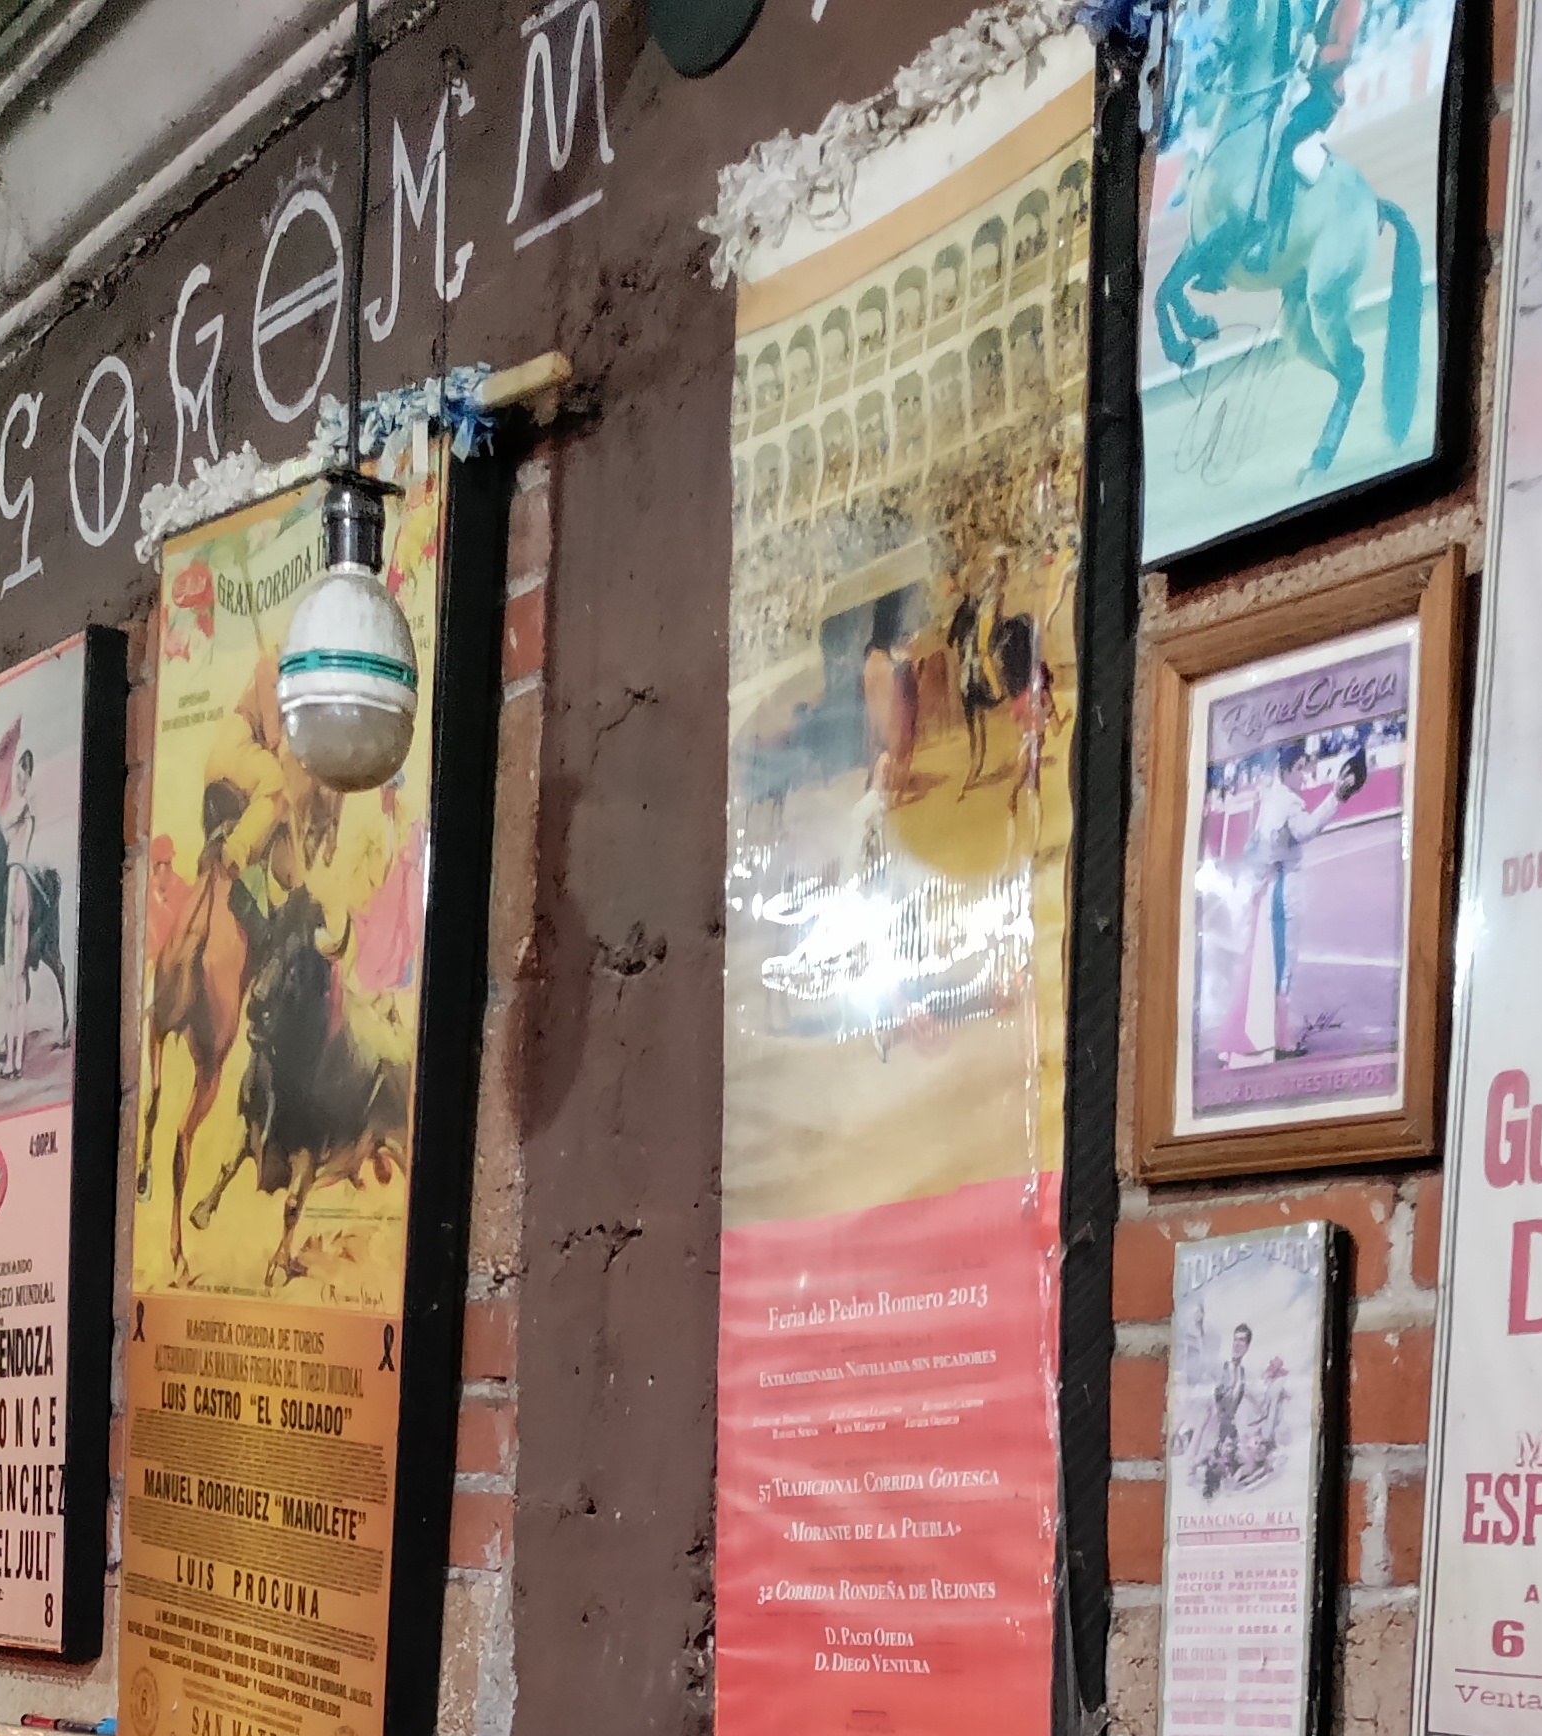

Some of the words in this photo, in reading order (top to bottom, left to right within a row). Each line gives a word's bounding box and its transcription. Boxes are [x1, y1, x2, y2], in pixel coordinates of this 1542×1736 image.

[216, 572, 254, 617] GRAN
[256, 545, 313, 614] CORRIDA
[1301, 671, 1398, 720] Ortega
[768, 1303, 806, 1332] Feria
[808, 1301, 826, 1326] de
[828, 1295, 875, 1323] Pedro
[877, 1290, 945, 1316] Romero
[946, 1283, 989, 1309] 2013
[160, 1380, 187, 1412] LUIS
[193, 1384, 242, 1421] CASTRO
[143, 1467, 194, 1506] MANUEL
[196, 1478, 271, 1522] RODRIGUEZ
[758, 1484, 772, 1504] 57
[771, 1476, 862, 1498] TRADICIONAL
[862, 1470, 925, 1493] CORRIDA
[928, 1466, 1001, 1489] GOYESCA
[854, 1524, 874, 1540] DE
[876, 1522, 898, 1540] LA
[175, 1554, 215, 1592] LUIS
[232, 1568, 320, 1620] PROCUNA
[774, 1579, 836, 1601] CORRIDA
[838, 1579, 907, 1601] RONDEÑA
[908, 1583, 928, 1600] DE
[930, 1578, 997, 1600] REJONES
[1524, 1583, 1540, 1604] A
[44, 1592, 54, 1628] 8
[873, 1627, 915, 1647] OJEDA
[1490, 1618, 1526, 1659] 6
[831, 1652, 871, 1673] DIEGO
[871, 1653, 932, 1674] VENTURA
